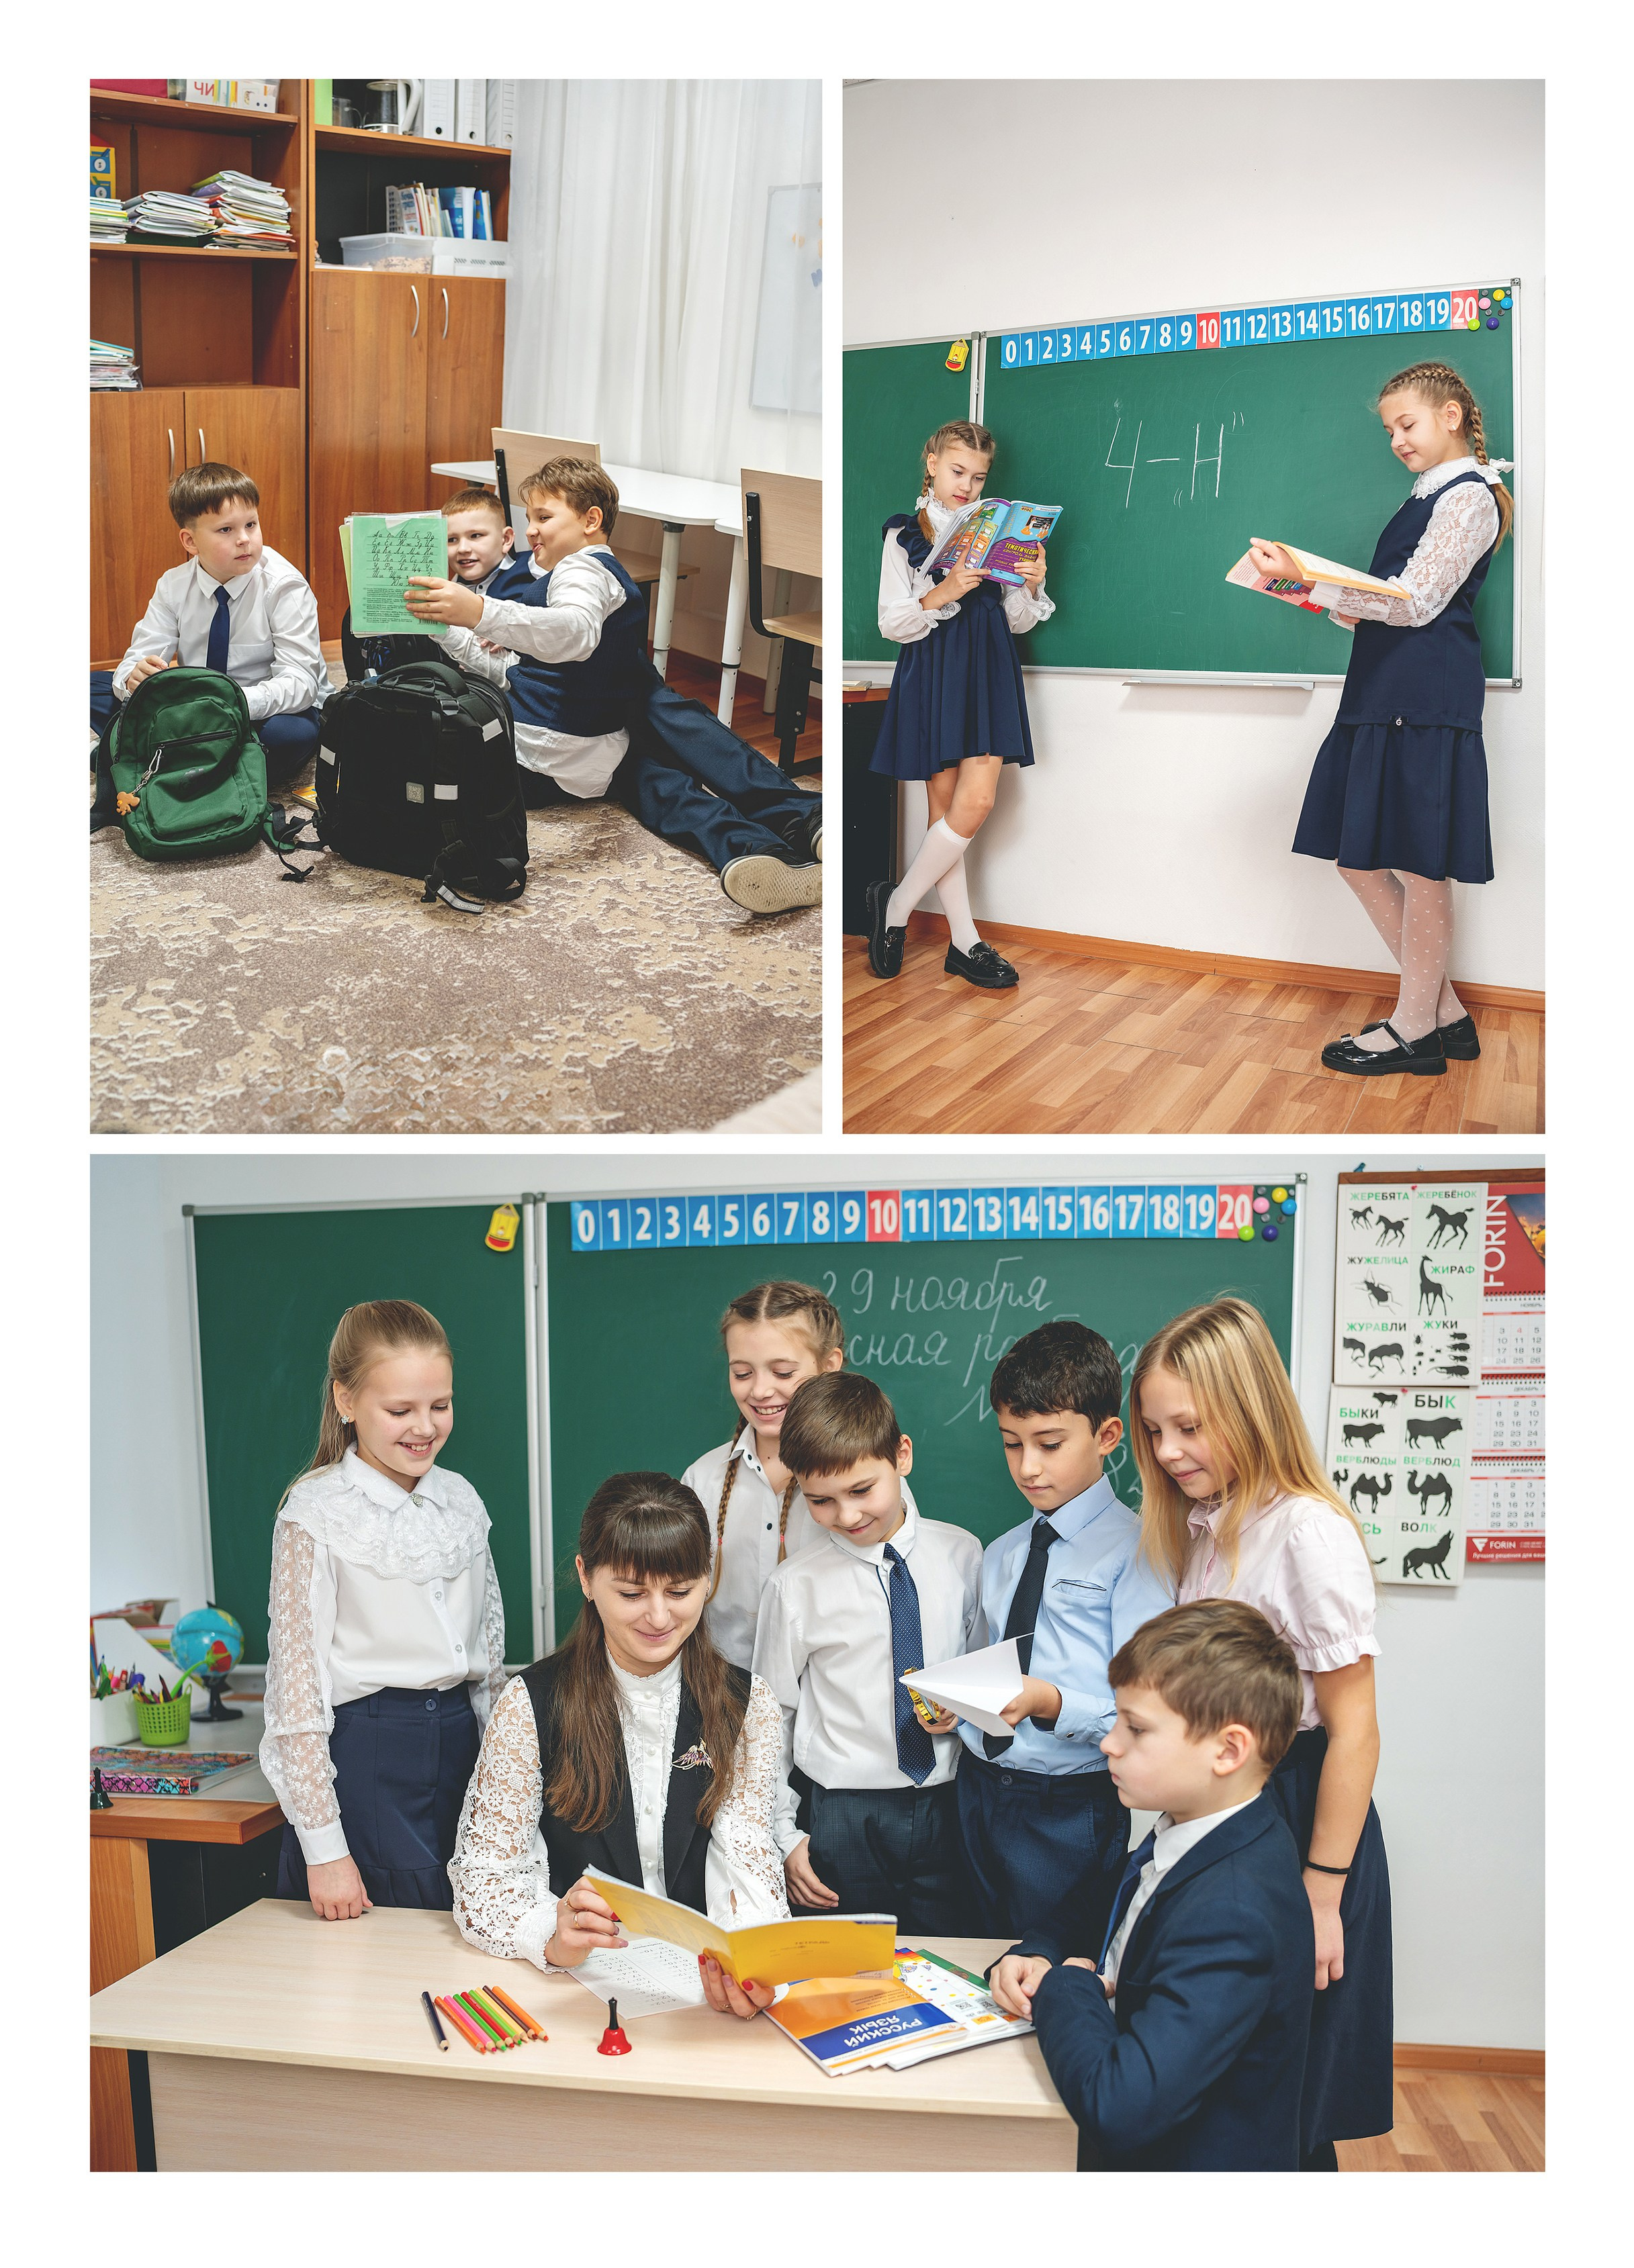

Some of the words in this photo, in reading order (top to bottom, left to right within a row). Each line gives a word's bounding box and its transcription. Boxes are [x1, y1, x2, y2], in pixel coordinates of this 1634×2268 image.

[1005, 340, 1017, 363] 0
[1025, 338, 1032, 361] 1
[1042, 336, 1052, 359] 2
[1061, 334, 1071, 357] 3
[1080, 332, 1092, 355] 4
[1100, 330, 1110, 353] 5
[1120, 327, 1131, 351] 6
[1140, 325, 1150, 349] 7
[1160, 323, 1171, 347] 8
[1181, 321, 1192, 346] 9
[1199, 318, 1218, 344] 10
[1223, 316, 1240, 342] 11
[1247, 314, 1267, 339] 12
[1271, 312, 1291, 337] 13
[1296, 309, 1318, 335] 14
[1322, 307, 1343, 332] 15
[1348, 304, 1370, 330] 16
[1374, 302, 1395, 328] 17
[1400, 300, 1423, 327] 18
[1426, 298, 1449, 325] 19
[1452, 296, 1478, 324] 20
[396, 538, 412, 547] Жж
[373, 553, 380, 562] Оо
[383, 563, 394, 572] Фф
[1350, 1192, 1409, 1200] ЖЕРЕБЯТА
[1417, 1190, 1477, 1199] ЖЕРЕБЁНОК
[578, 1210, 595, 1243] 0
[608, 1209, 620, 1241] 1
[636, 1207, 651, 1240] 2
[665, 1206, 680, 1239] 3
[694, 1204, 711, 1238] 4
[723, 1204, 739, 1237] 5
[753, 1202, 770, 1236] 6
[783, 1202, 799, 1235] 7
[813, 1200, 830, 1235] 8
[843, 1200, 860, 1234] 9
[870, 1198, 897, 1233] 10
[904, 1198, 929, 1233] 11
[939, 1197, 967, 1232] 12
[973, 1196, 1001, 1232] 13
[1008, 1196, 1039, 1231] 14
[1044, 1195, 1073, 1231] 15
[1079, 1195, 1109, 1231] 16
[1114, 1194, 1144, 1230] 17
[1149, 1194, 1179, 1230] 18
[1185, 1194, 1215, 1230] 19
[1218, 1194, 1251, 1229] 20
[1484, 1194, 1507, 1287] FORIN
[1347, 1256, 1408, 1266] ЖУЖЕЛИЦА
[1431, 1266, 1475, 1274] ЖИРАФ
[891, 1256, 1054, 1333] ноября
[1347, 1323, 1407, 1331] ЖУРАВЛИ
[1423, 1320, 1458, 1329] ЖУКИ
[846, 1330, 952, 1366] сная
[1414, 1395, 1456, 1409] БЫК
[1339, 1407, 1379, 1419] БЫКИ
[1336, 1455, 1397, 1465] ВЕРБЛЮДЫ
[1404, 1456, 1461, 1468] ВЕРБЛЮД
[1362, 1523, 1381, 1534] СЬ
[1401, 1522, 1437, 1533] ВОЛК
[1490, 1541, 1516, 1549] FORIN
[848, 2015, 900, 2034] ЯЗЫК
[844, 2018, 923, 2048] РУССКИЙ
